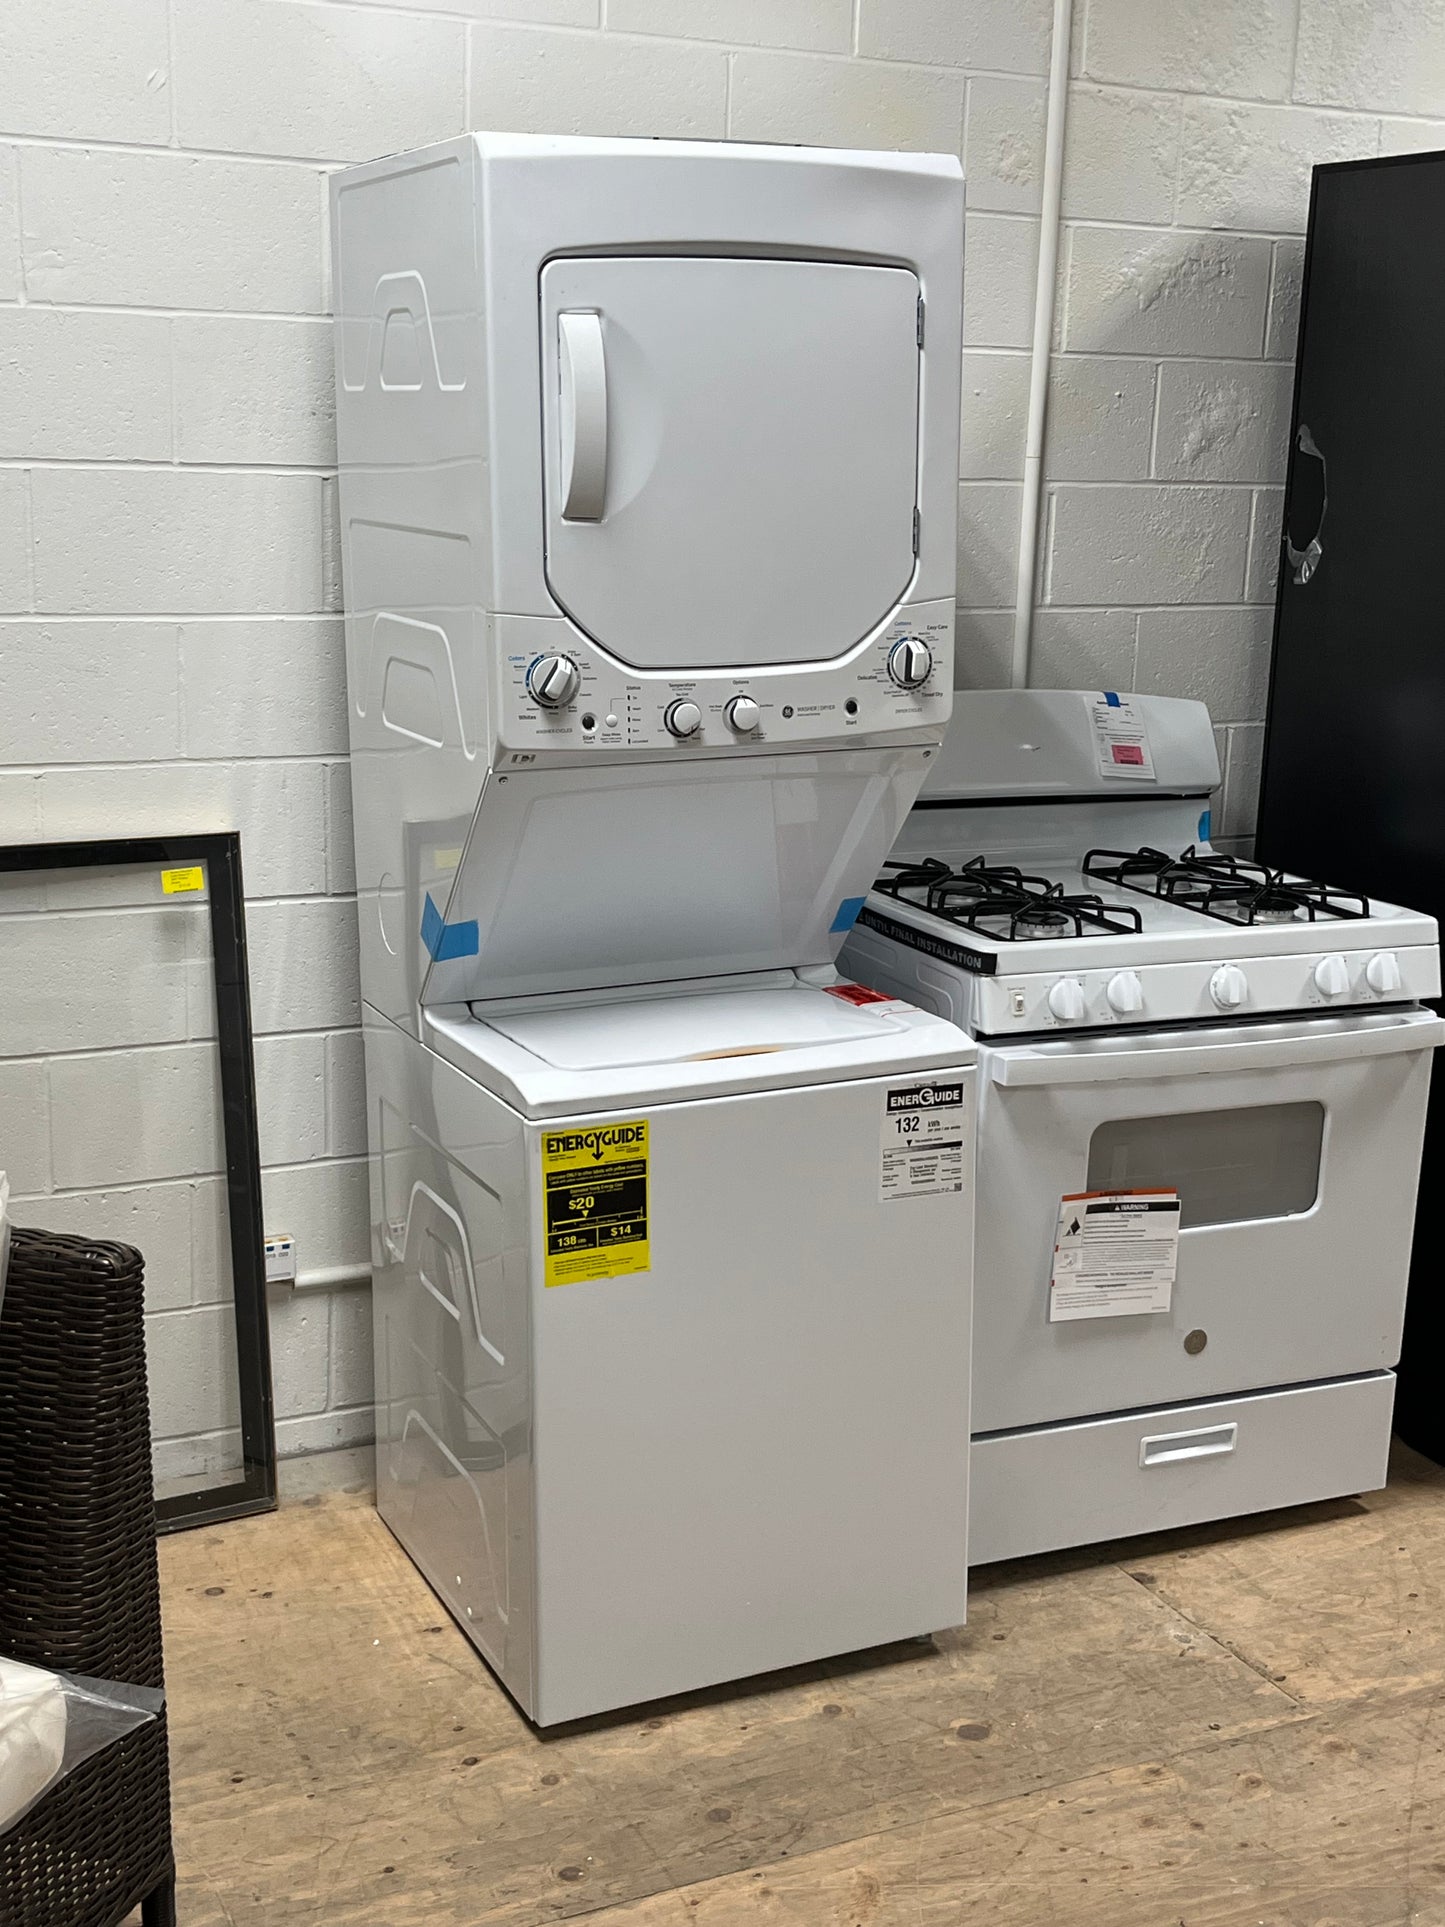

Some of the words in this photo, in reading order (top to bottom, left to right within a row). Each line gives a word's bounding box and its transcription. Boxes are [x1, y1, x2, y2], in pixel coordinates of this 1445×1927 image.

[865, 915, 890, 935] UNTIL
[890, 925, 916, 944] FINAL
[916, 936, 982, 969] INSTALLATION
[890, 1088, 960, 1107] ENERGUIDE
[895, 1116, 920, 1134] 132
[546, 1126, 645, 1154] ENERGYGUIDE
[568, 1196, 595, 1210] $20
[610, 1225, 632, 1236] $14
[557, 1236, 577, 1248] 138
